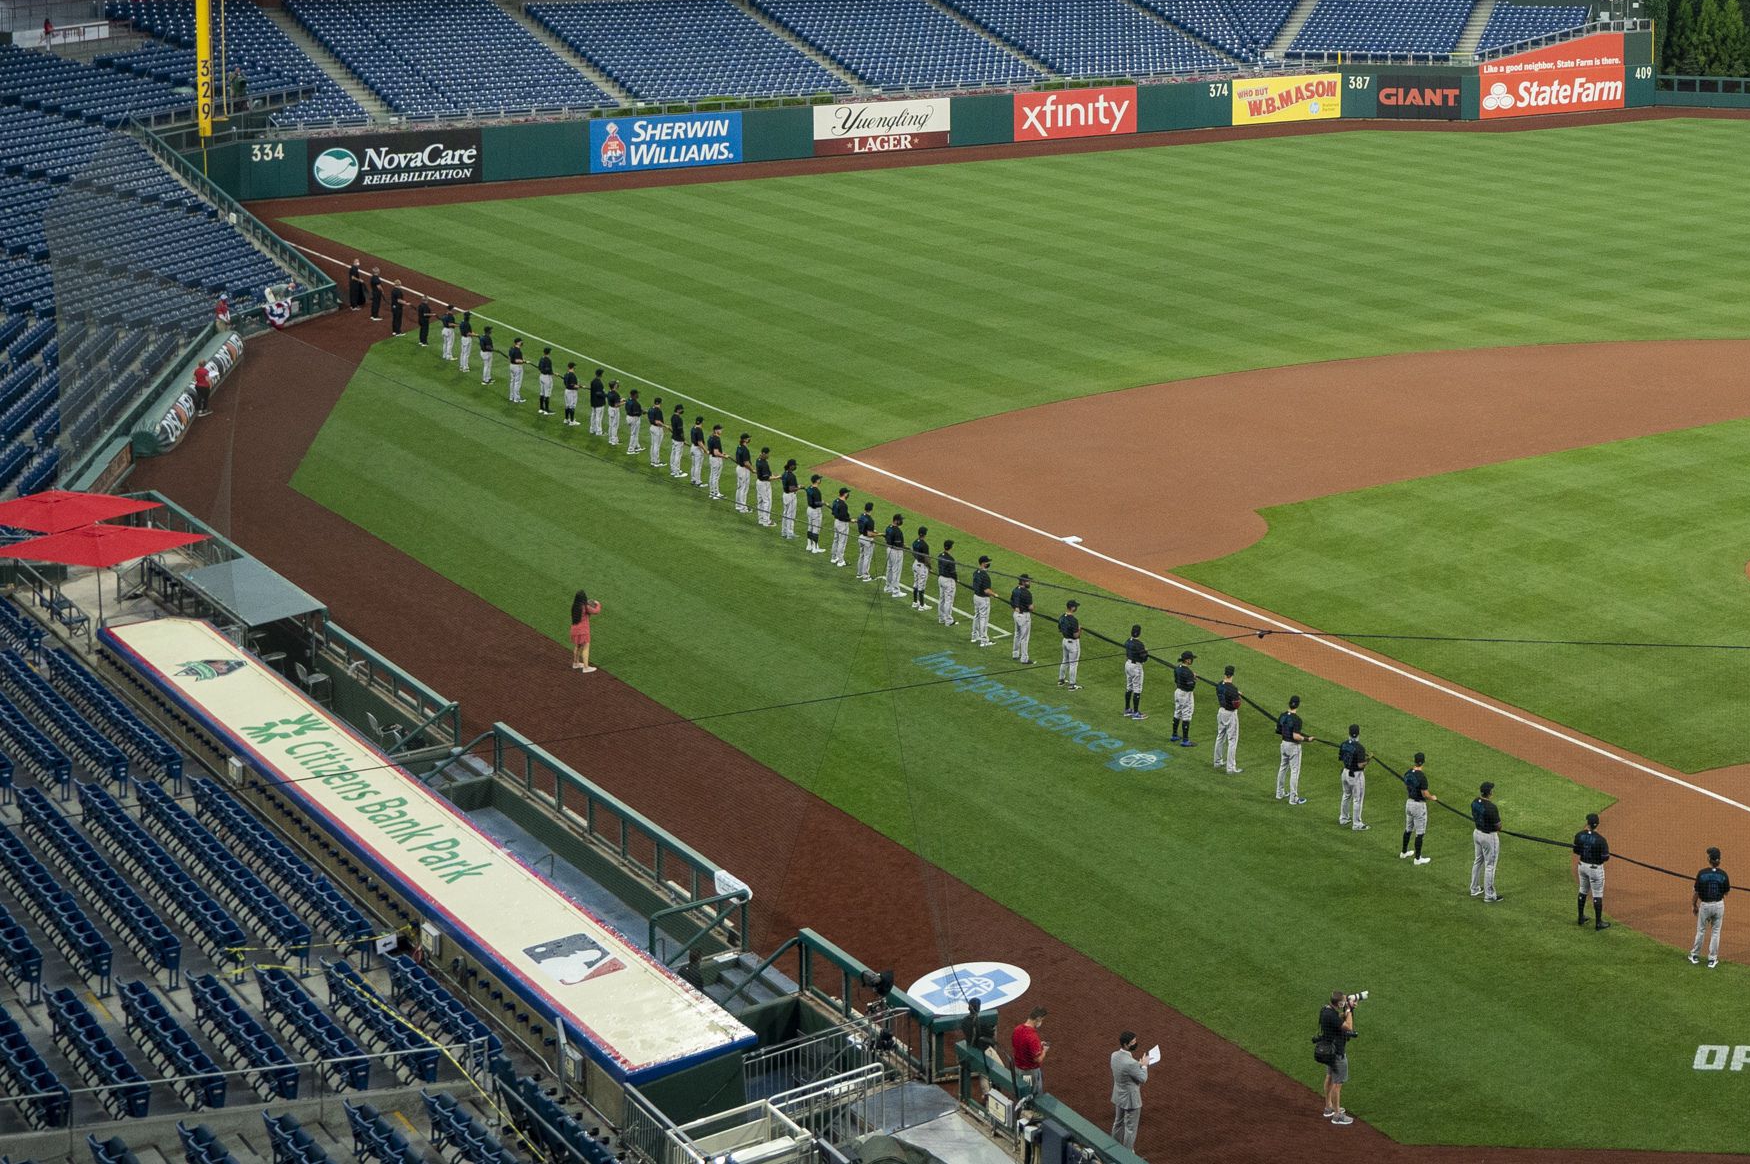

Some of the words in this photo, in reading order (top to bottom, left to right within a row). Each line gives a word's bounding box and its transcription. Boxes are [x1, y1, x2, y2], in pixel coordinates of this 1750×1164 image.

[1483, 64, 1498, 73] Like
[1505, 64, 1522, 73] good
[1524, 62, 1556, 72] neighbor,
[1557, 60, 1574, 68] State
[1575, 59, 1593, 67] Farm
[1594, 58, 1600, 66] is
[1601, 57, 1621, 65] there.
[1635, 67, 1652, 80] 409
[1209, 83, 1229, 98] 374
[1349, 76, 1370, 89] 387
[1237, 89, 1253, 99] WHO
[1255, 87, 1268, 96] BUT
[1379, 87, 1460, 106] GIANT
[831, 105, 934, 135] Yuengling
[1022, 94, 1130, 137] xfinity
[631, 119, 729, 142] SHERWIN
[252, 143, 284, 161] 334
[853, 134, 913, 153] LAGER
[361, 143, 473, 171] NovaCare
[362, 168, 473, 185] REHABILITATION
[911, 650, 1125, 753] Independence
[286, 739, 380, 817] Citizens
[355, 797, 424, 846] Bank
[413, 837, 492, 885] Park
